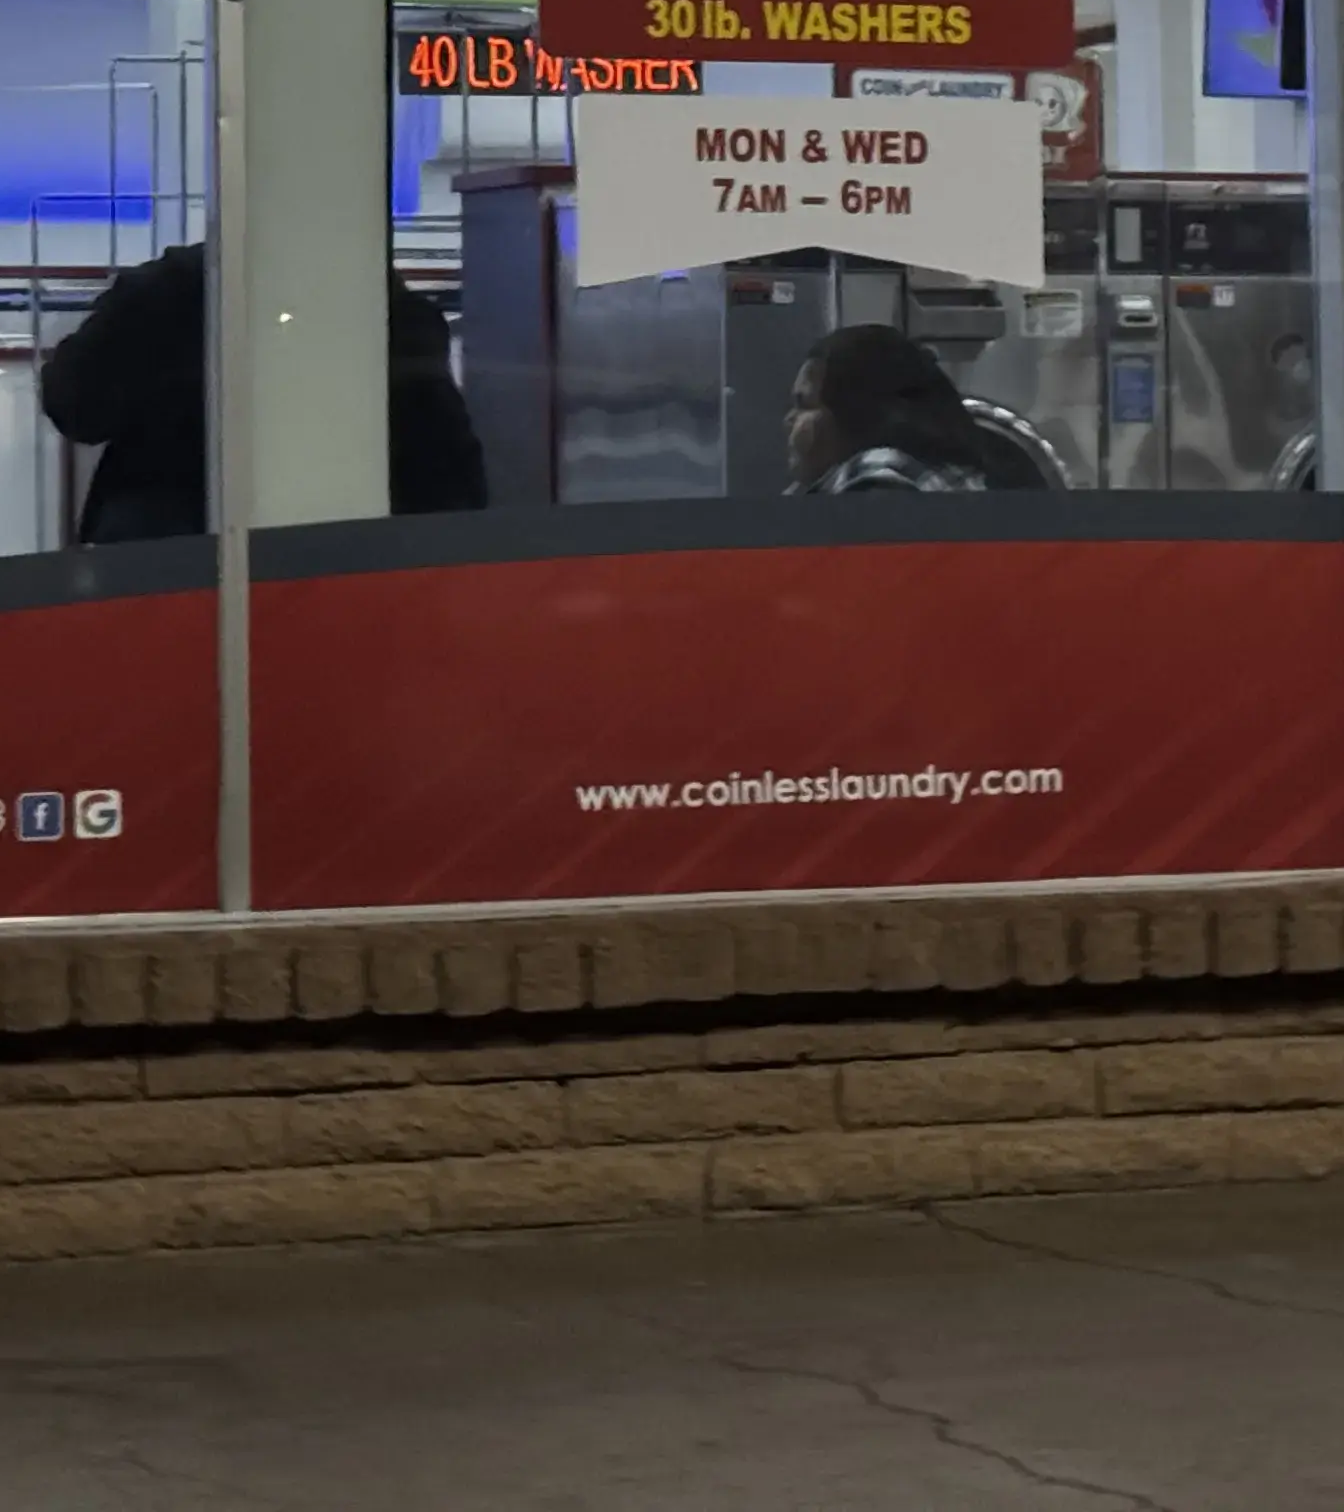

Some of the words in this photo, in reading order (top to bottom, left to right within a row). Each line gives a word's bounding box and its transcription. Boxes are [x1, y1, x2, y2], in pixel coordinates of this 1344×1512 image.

[702, 0, 751, 41] lb.
[763, 1, 972, 45] WASHERS
[410, 35, 457, 87] 40
[466, 36, 518, 88] LB
[696, 127, 786, 162] MON
[801, 129, 829, 163] &
[841, 130, 928, 164] WED
[712, 178, 787, 213] 7AM
[841, 179, 912, 214] 6PM
[575, 764, 1063, 813] www.coinlesslaundry.com
